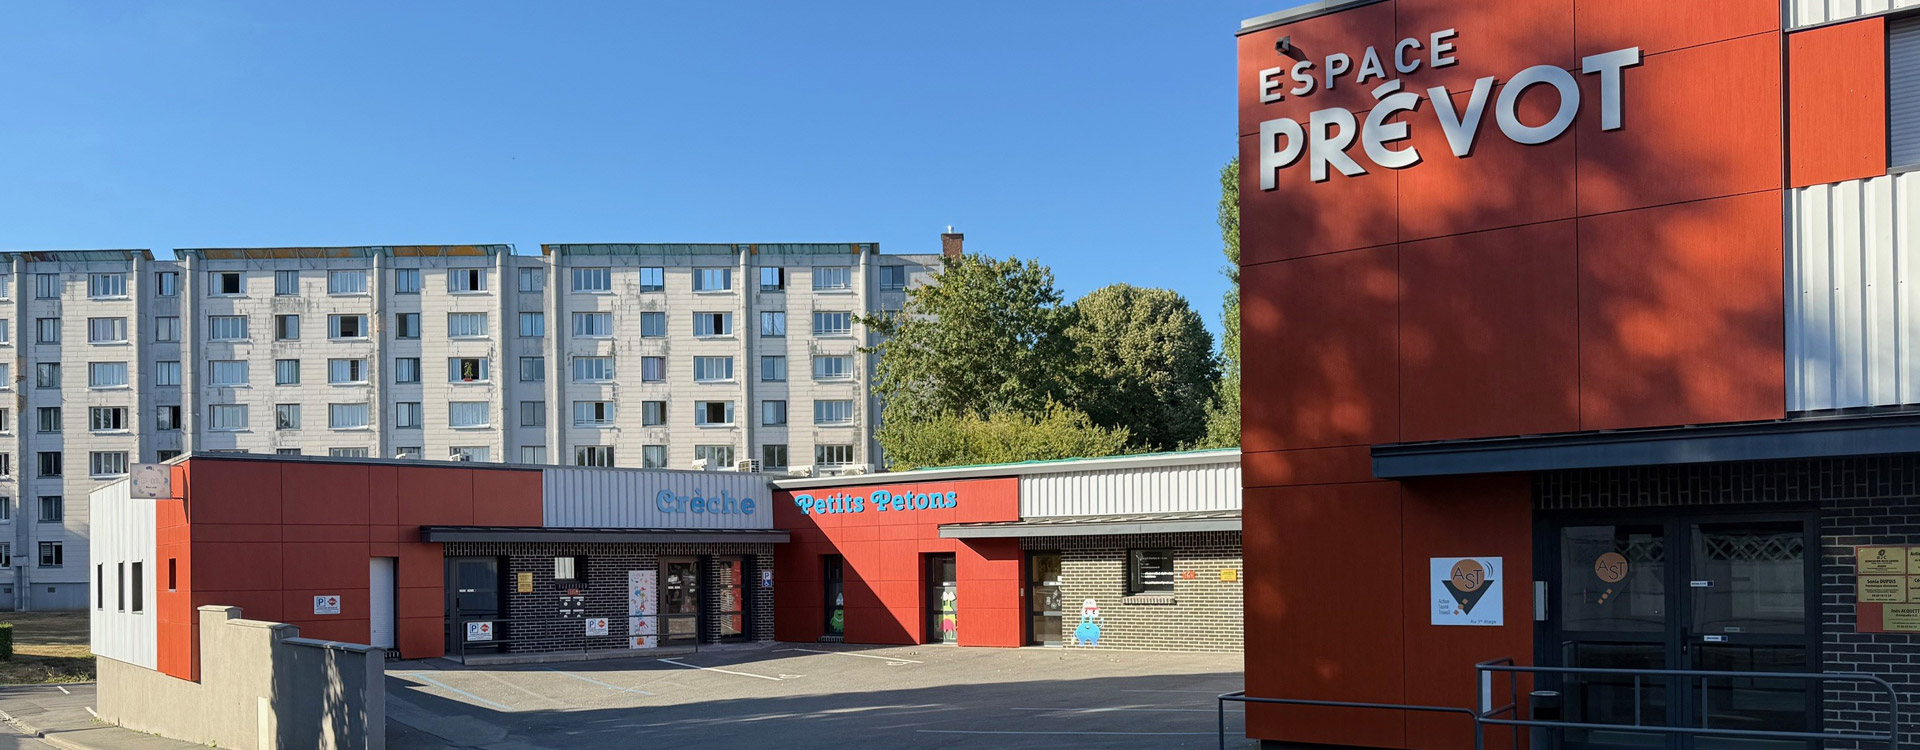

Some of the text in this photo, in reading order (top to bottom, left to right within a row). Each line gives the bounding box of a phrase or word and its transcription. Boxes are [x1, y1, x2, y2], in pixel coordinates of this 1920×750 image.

[1259, 28, 1458, 104] ESPACE
[1259, 46, 1640, 191] PRÉVOT
[656, 488, 756, 515] Crèche
[794, 489, 958, 515] Petits Petons
[1453, 567, 1482, 589] AST
[1596, 560, 1625, 580] AST
[471, 624, 477, 632] P
[589, 620, 595, 628] P
